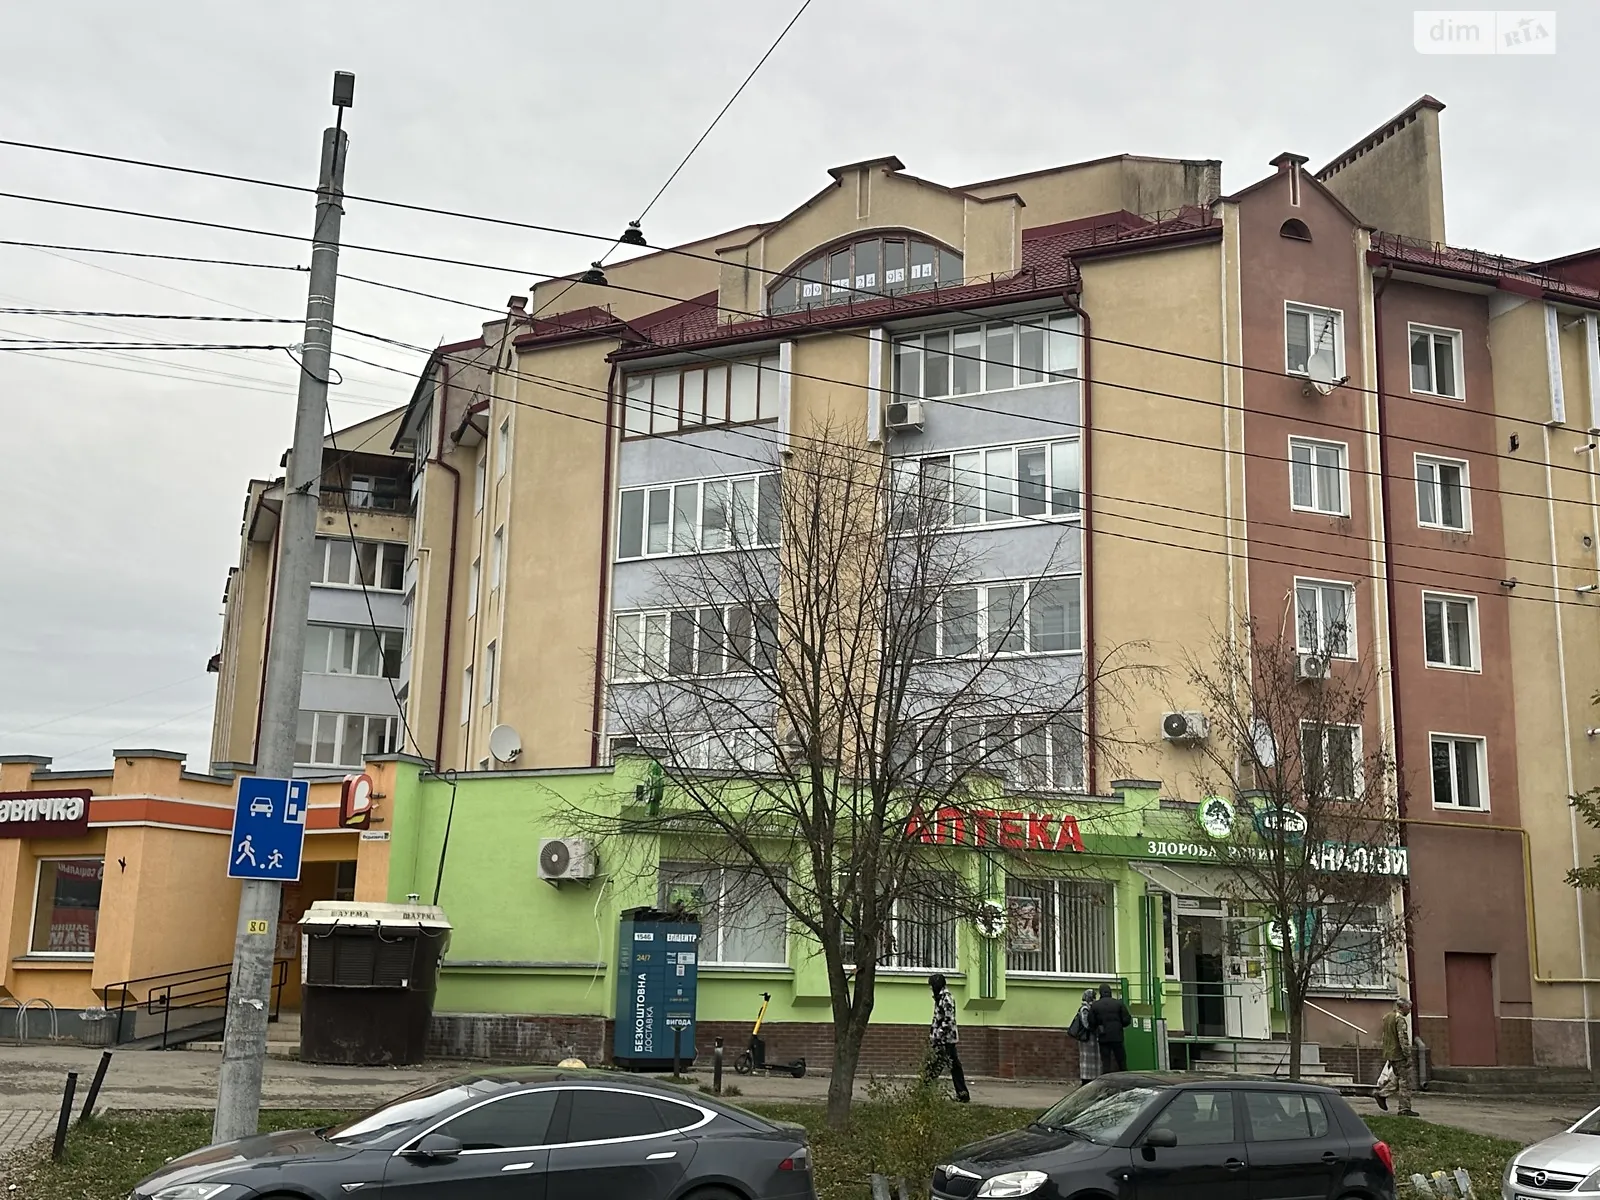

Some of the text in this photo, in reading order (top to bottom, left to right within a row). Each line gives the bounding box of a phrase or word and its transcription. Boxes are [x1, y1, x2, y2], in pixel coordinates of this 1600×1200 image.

[0, 797, 84, 823] авичка
[900, 803, 1085, 853] АПТЕКА
[250, 921, 266, 932] 80
[634, 973, 647, 1052] БЕЗКОШТОВНА
[645, 1006, 654, 1052] ДОСТАВКА
